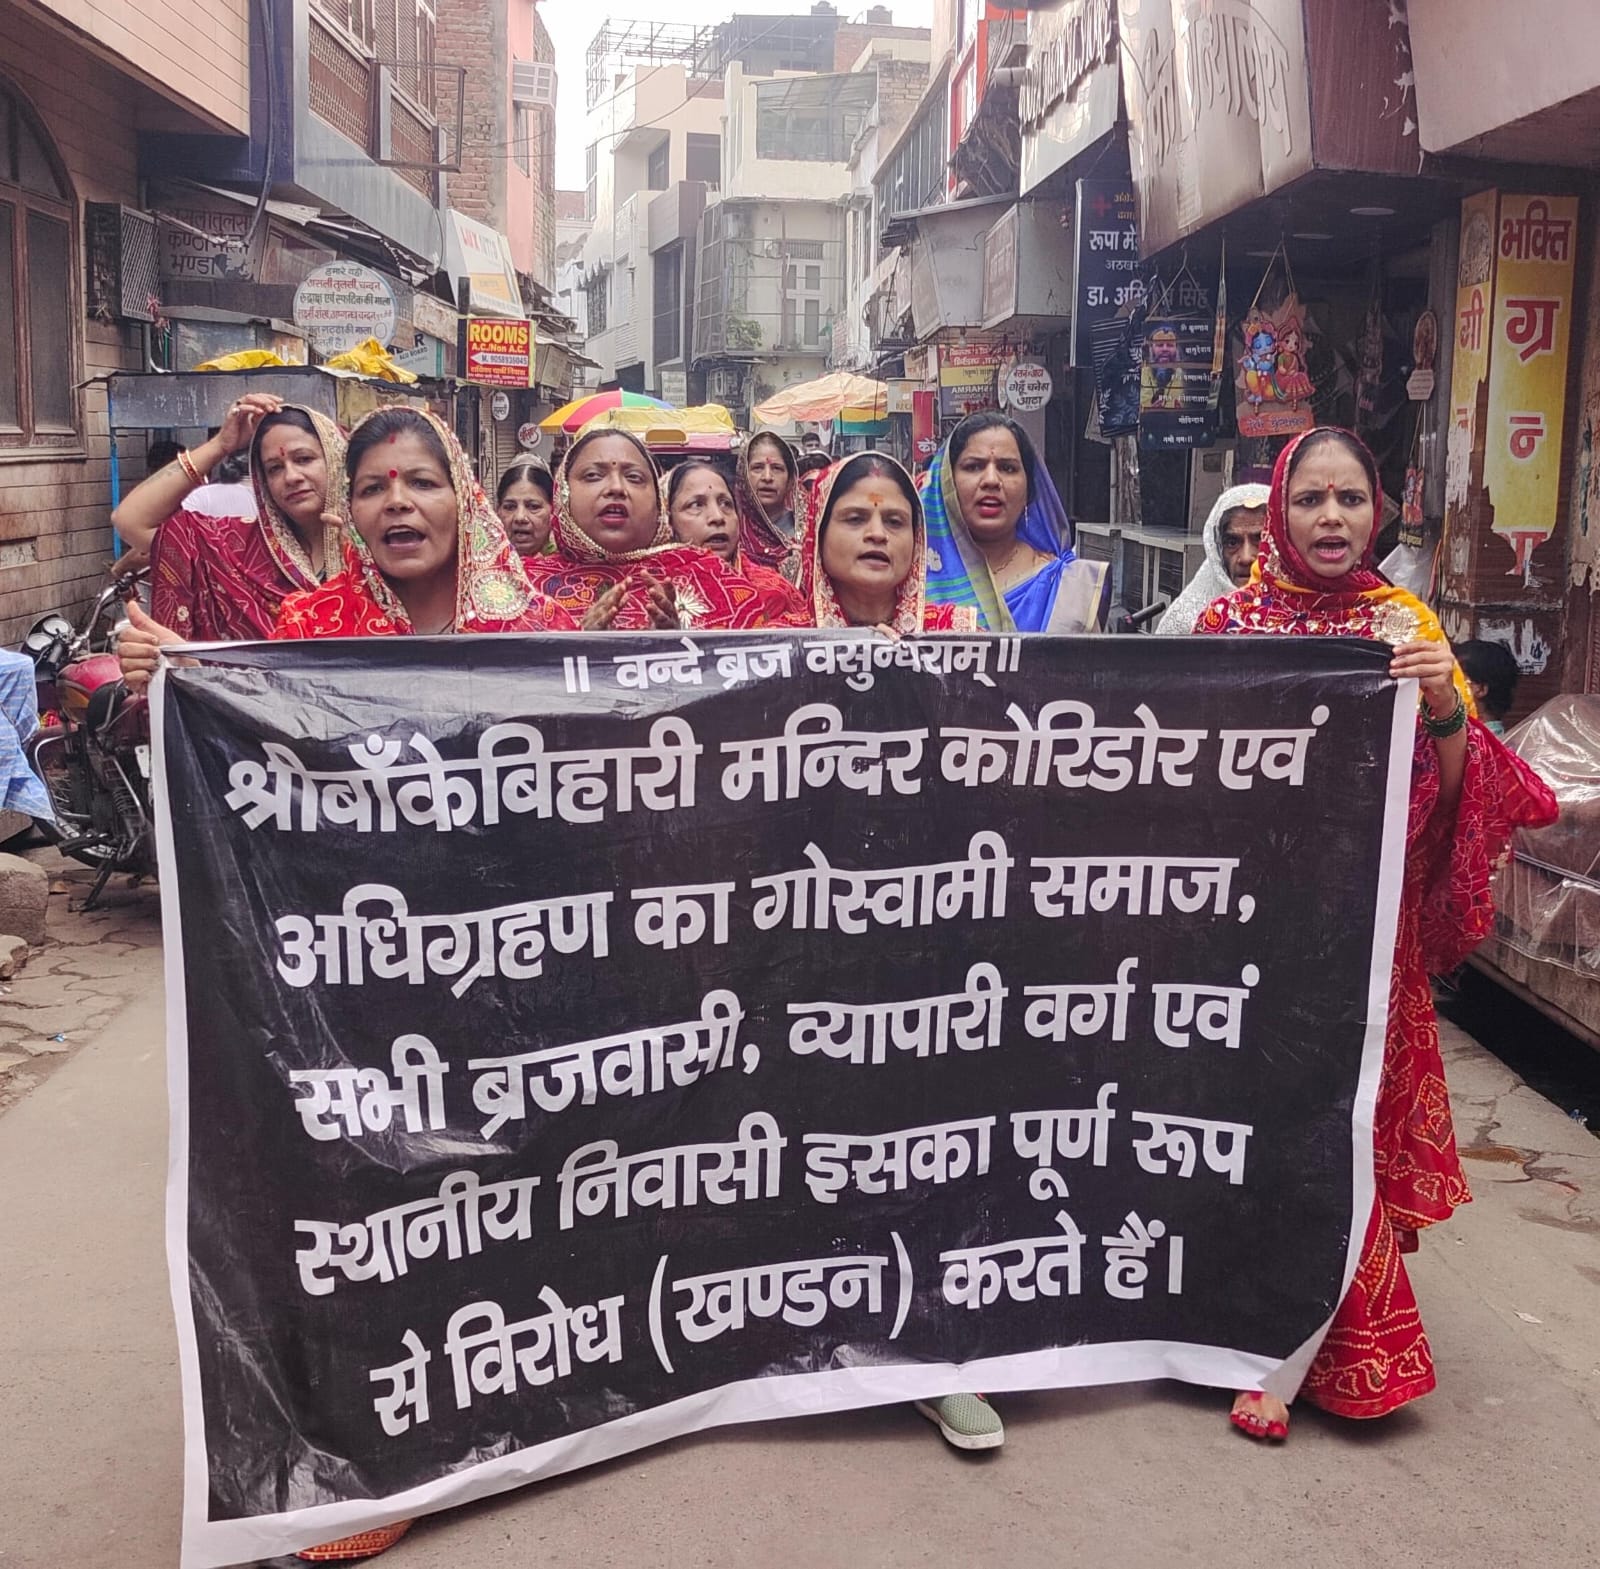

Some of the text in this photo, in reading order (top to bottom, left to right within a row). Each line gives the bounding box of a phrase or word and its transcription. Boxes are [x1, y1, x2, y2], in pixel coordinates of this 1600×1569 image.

[1089, 229, 1119, 251] रूपा
[1502, 201, 1572, 262] भक्ति
[1087, 286, 1109, 307] डा.
[470, 324, 528, 345] ROOMS
[509, 344, 526, 354] A.C.
[613, 637, 704, 690] वन्दे
[714, 643, 792, 691] ब्रज
[224, 699, 1330, 833] श्रीबाँकेबिहारी मन्दिर कोरिडोर एवं
[275, 830, 1256, 999] अधिग्रहण का गोस्वामी समाज,
[289, 957, 1260, 1141] सभी ब्रजवासी, व्यापारी वर्ग एवं
[294, 1082, 1254, 1296] स्थानीय निवासी इसका पूर्ण रूप
[369, 1209, 1184, 1437] से विरोध (खण्डन) करते हैं।
